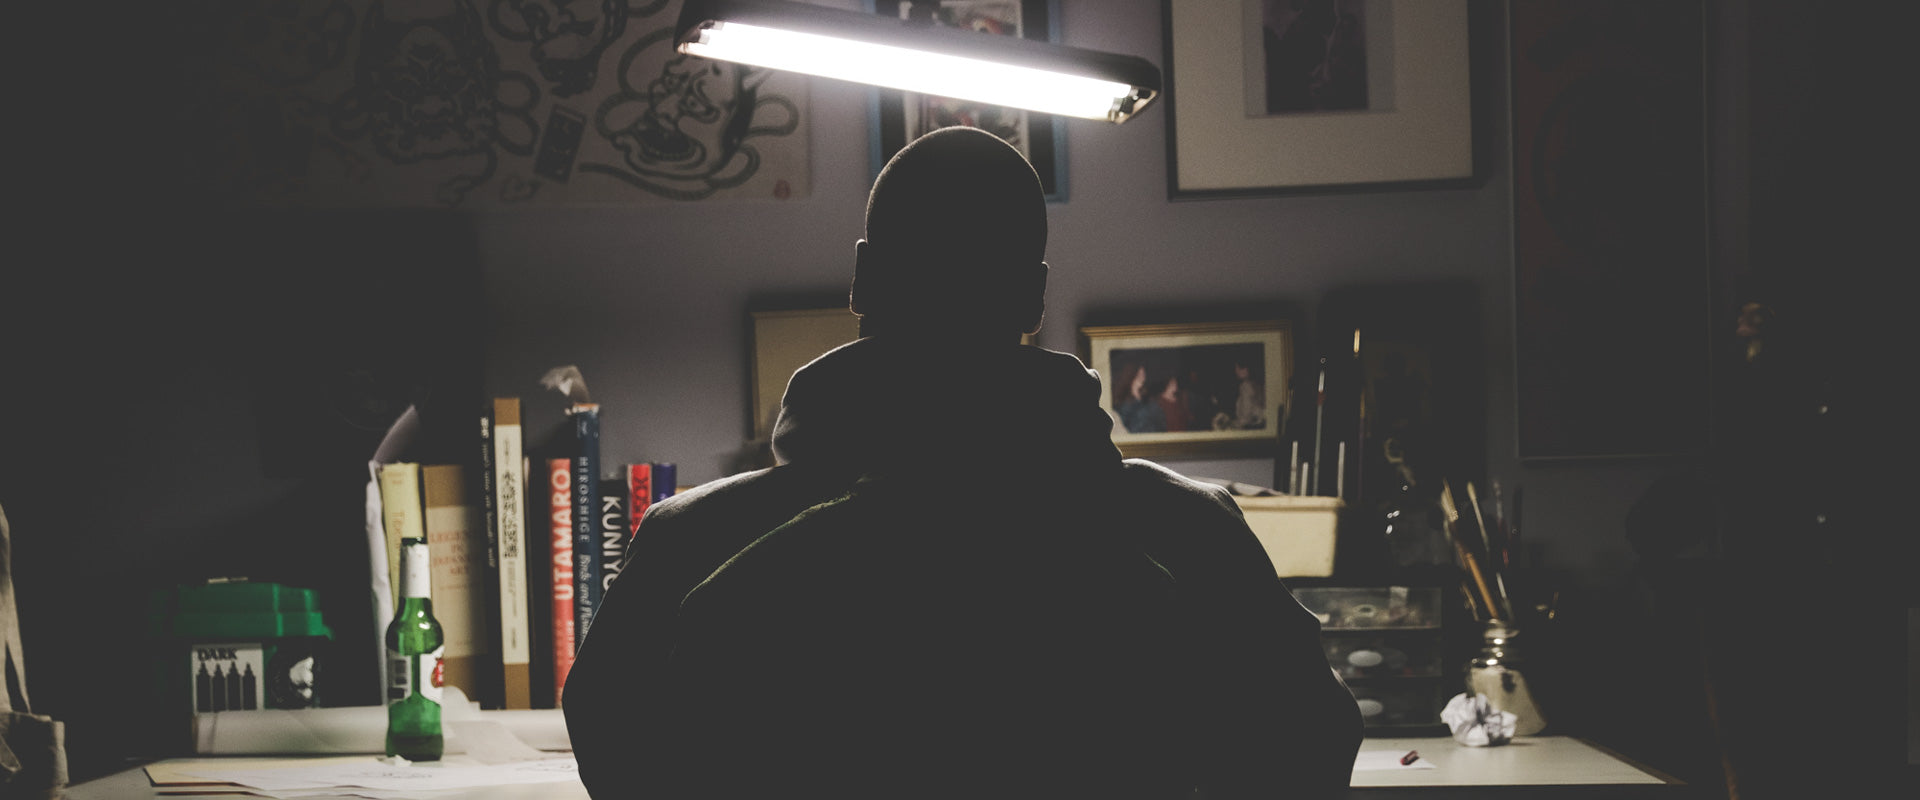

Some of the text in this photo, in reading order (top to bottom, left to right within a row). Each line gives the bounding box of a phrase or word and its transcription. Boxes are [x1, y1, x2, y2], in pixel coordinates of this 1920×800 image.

[551, 467, 574, 601] UTAMARO
[578, 456, 591, 543] HIROSHIGE
[197, 648, 238, 661] DARK
